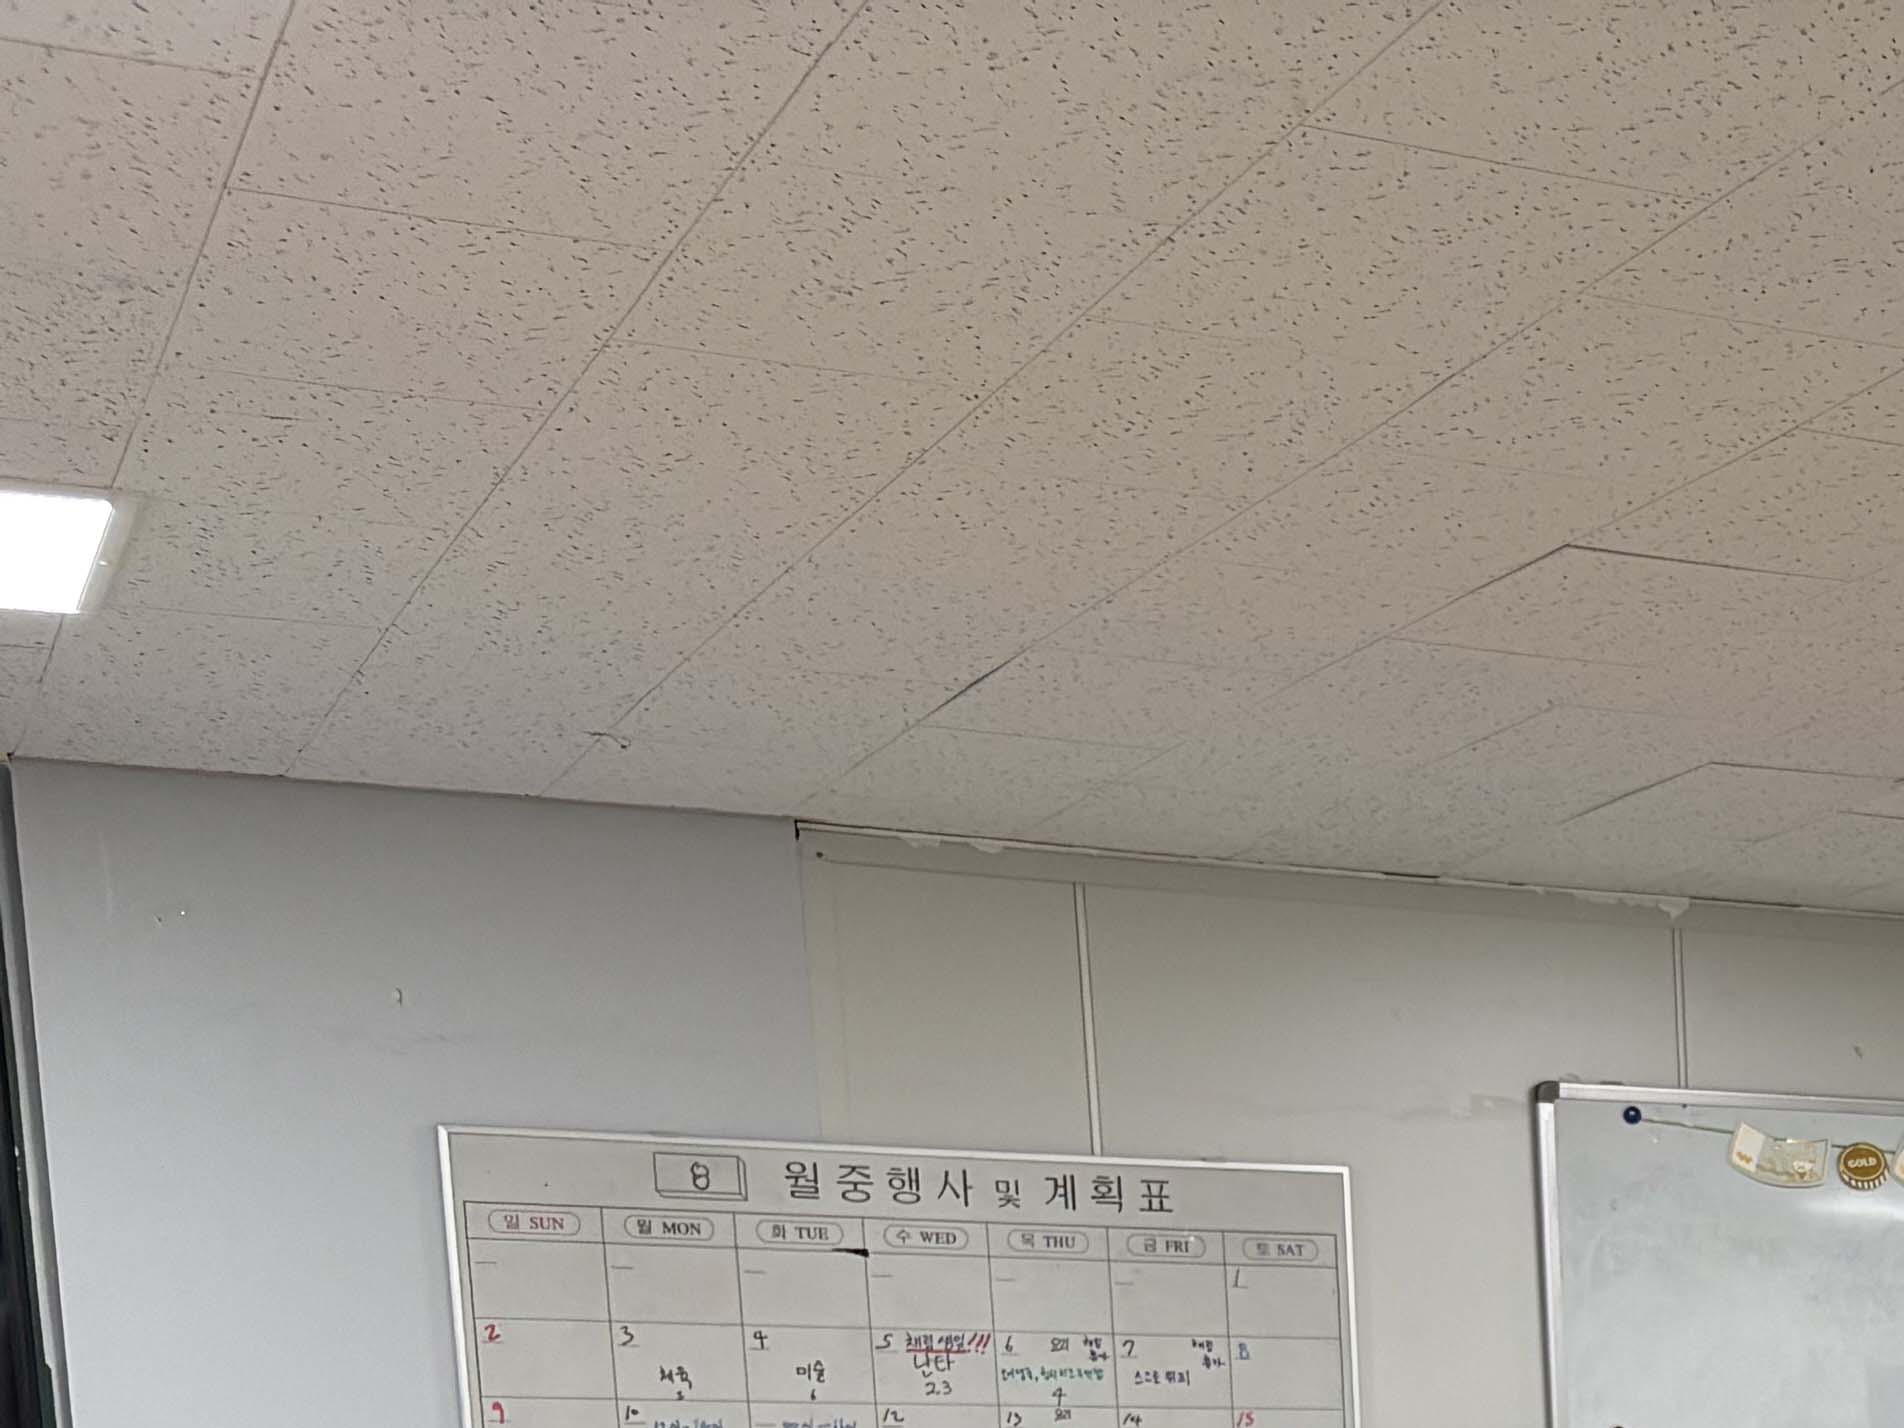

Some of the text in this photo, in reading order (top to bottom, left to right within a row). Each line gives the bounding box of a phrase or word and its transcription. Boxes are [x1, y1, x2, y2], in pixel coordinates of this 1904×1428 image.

[785, 1161, 973, 1207] 월중행사
[995, 1178, 1020, 1209] 및
[1045, 1174, 1173, 1213] 계획표
[504, 1214, 564, 1231] 일 SUN
[662, 1222, 701, 1236] MON
[794, 1227, 829, 1240] TUE
[896, 1230, 956, 1245] 수 WED
[1043, 1235, 1076, 1249] THU
[1165, 1239, 1189, 1253] FRI
[1277, 1243, 1304, 1257] SAT
[484, 1324, 501, 1342] 2
[619, 1326, 635, 1346] 3
[753, 1330, 768, 1350] 4
[875, 1334, 893, 1350] 5
[1122, 1340, 1135, 1357] 7
[913, 1353, 955, 1377] 난타
[883, 1408, 904, 1423] 12
[1237, 1411, 1254, 1428] 15
